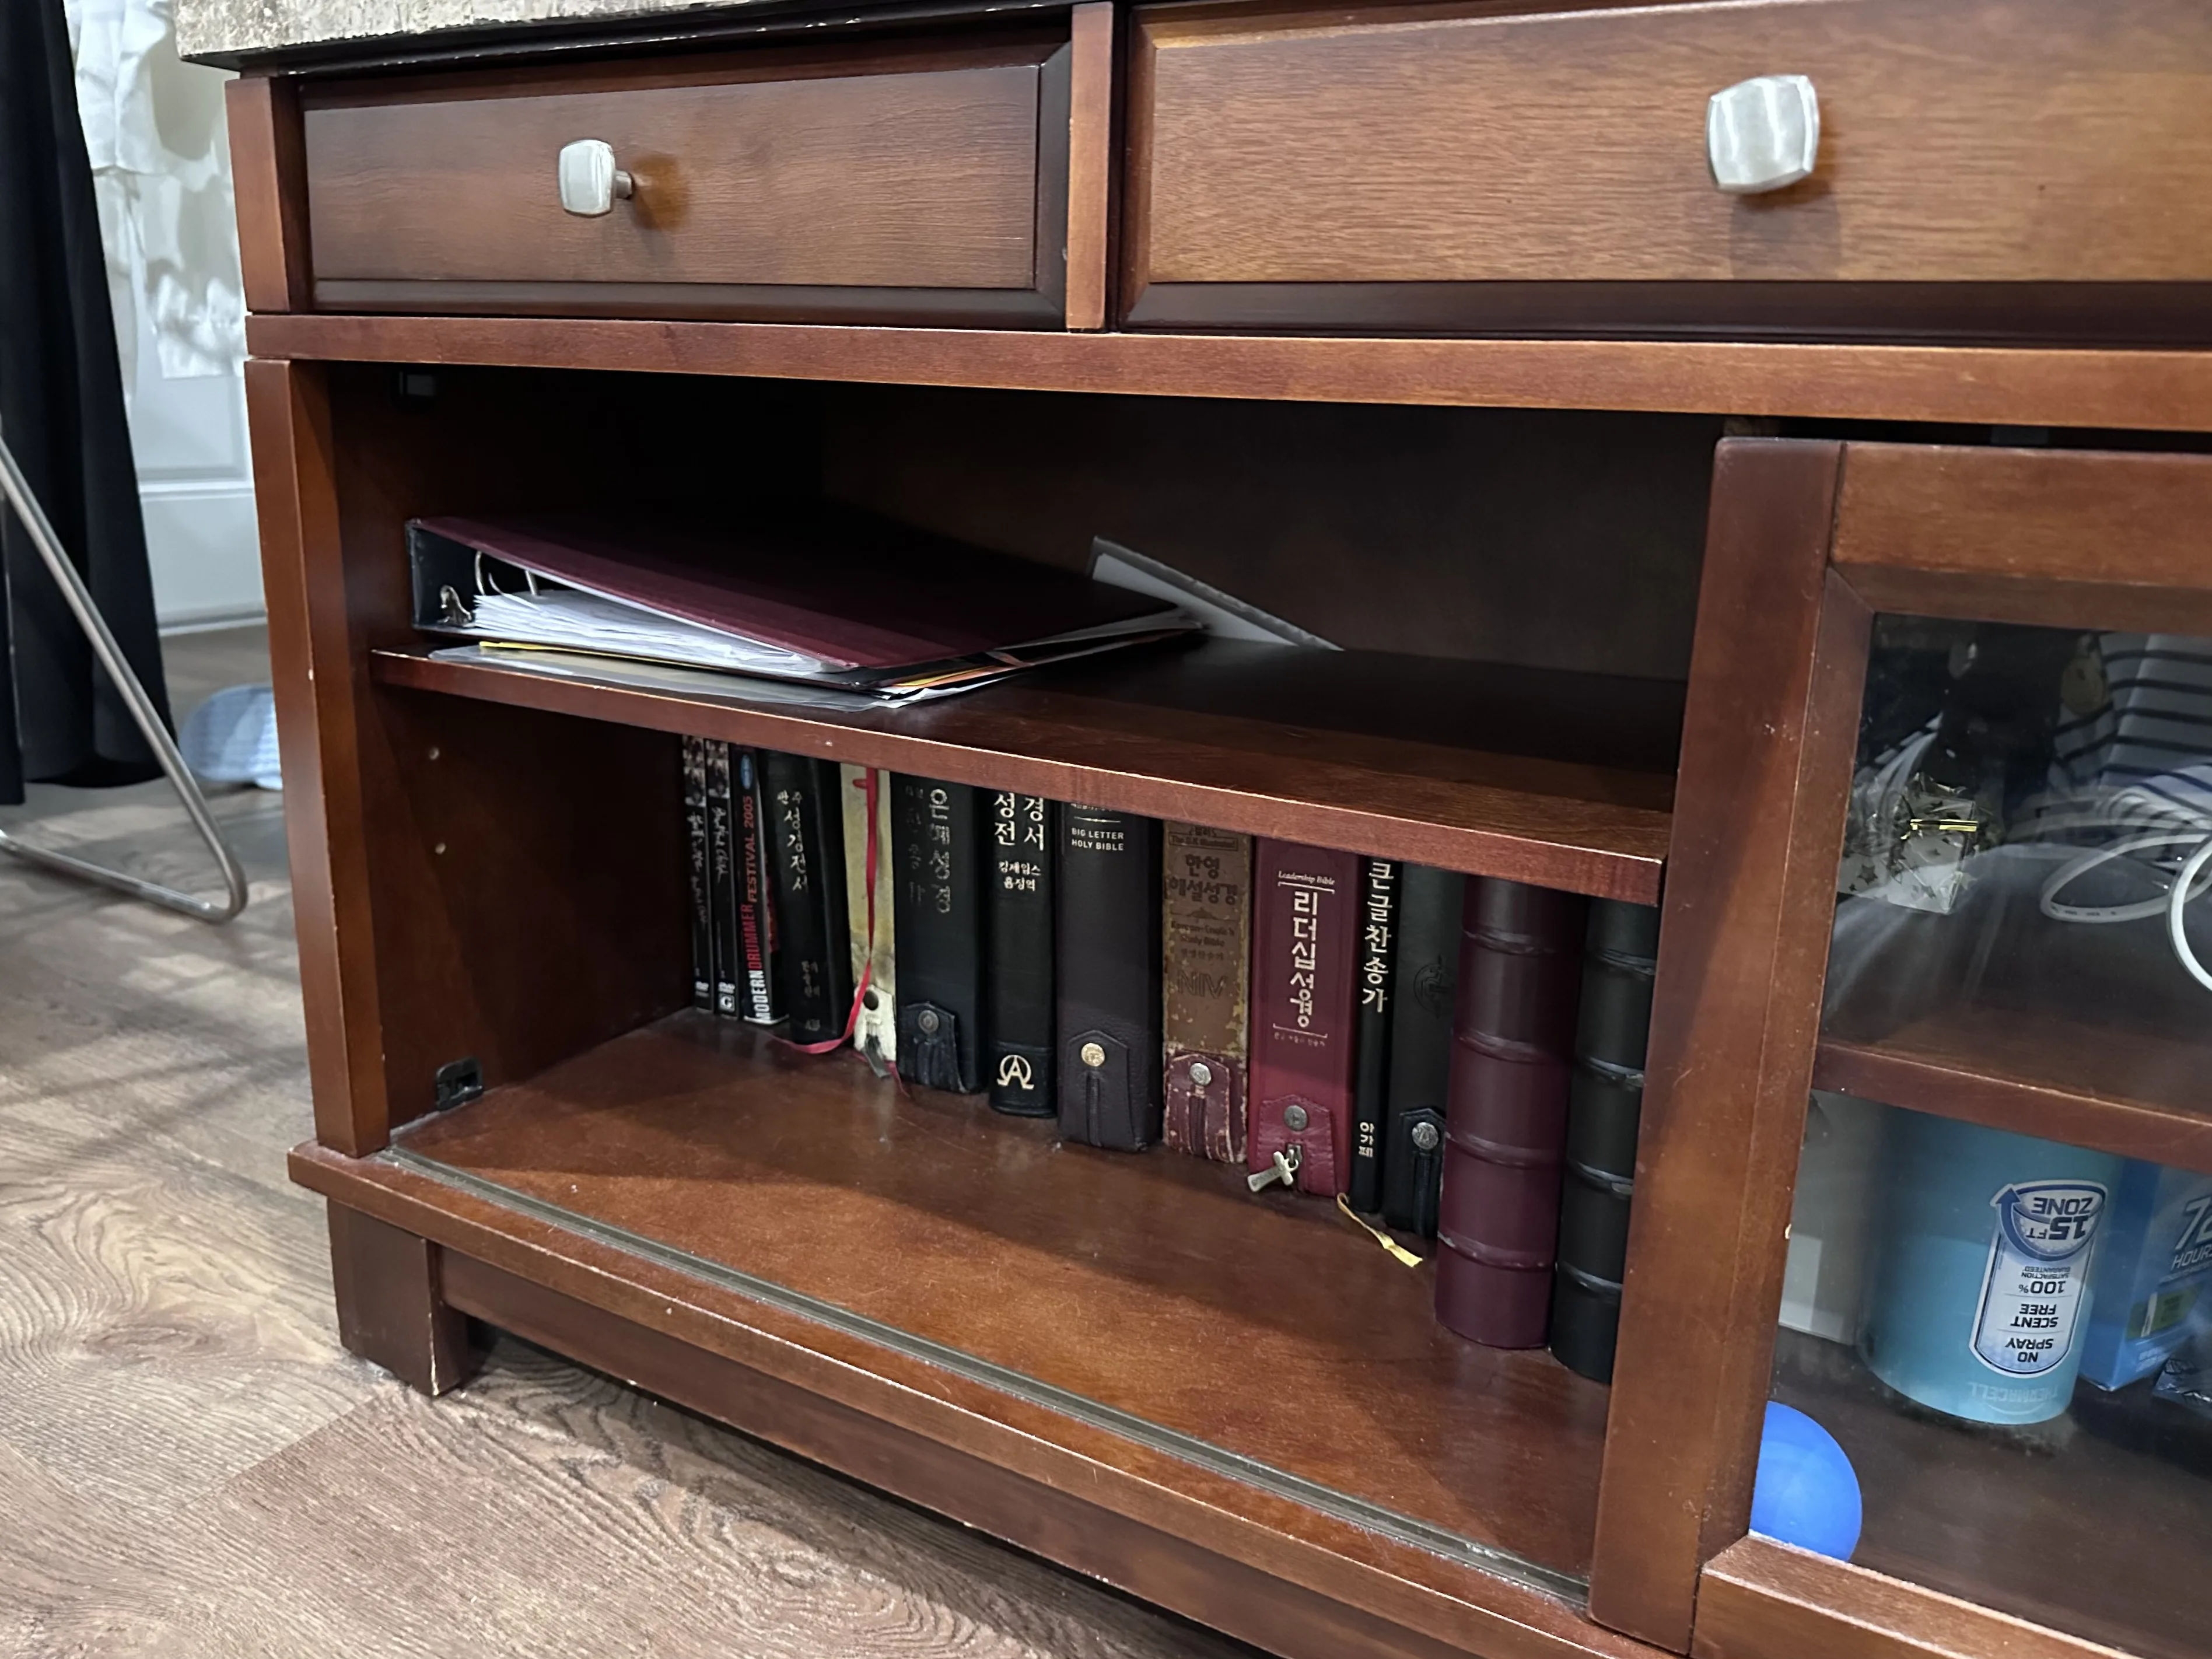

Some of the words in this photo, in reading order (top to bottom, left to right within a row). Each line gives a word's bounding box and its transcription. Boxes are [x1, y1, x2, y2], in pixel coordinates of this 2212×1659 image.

[743, 796, 754, 829] 2005
[994, 792, 1044, 821] 성경
[994, 820, 1044, 851] 전서
[1072, 828, 1086, 836] BIG
[1088, 831, 1124, 839] LETTER
[784, 807, 808, 893] 성경전서
[1072, 839, 1093, 848] HOLY
[1096, 842, 1124, 850] BIBLE
[746, 834, 757, 903] FESTIVAL
[999, 860, 1041, 876] 킹제임스
[1185, 854, 1220, 880] 한영
[1278, 870, 1315, 884] Leadership
[1317, 876, 1335, 885] Bible
[1003, 876, 1035, 891] 흠정역
[1169, 876, 1238, 905] 해설성경
[740, 905, 762, 971] DRUMMER
[748, 970, 771, 1020] MODERN
[1178, 970, 1228, 999] NIV
[1359, 1122, 1374, 1158] 아가페
[2031, 1197, 2094, 1215] ZONE
[2025, 1227, 2048, 1239] FT
[2048, 1215, 2089, 1240] 15
[2018, 1280, 2066, 1294] 100%
[2020, 1304, 2057, 1315] FREE
[2010, 1316, 2059, 1328] SCENT
[2005, 1338, 2054, 1349] SPRAY
[2017, 1352, 2038, 1363] NO
